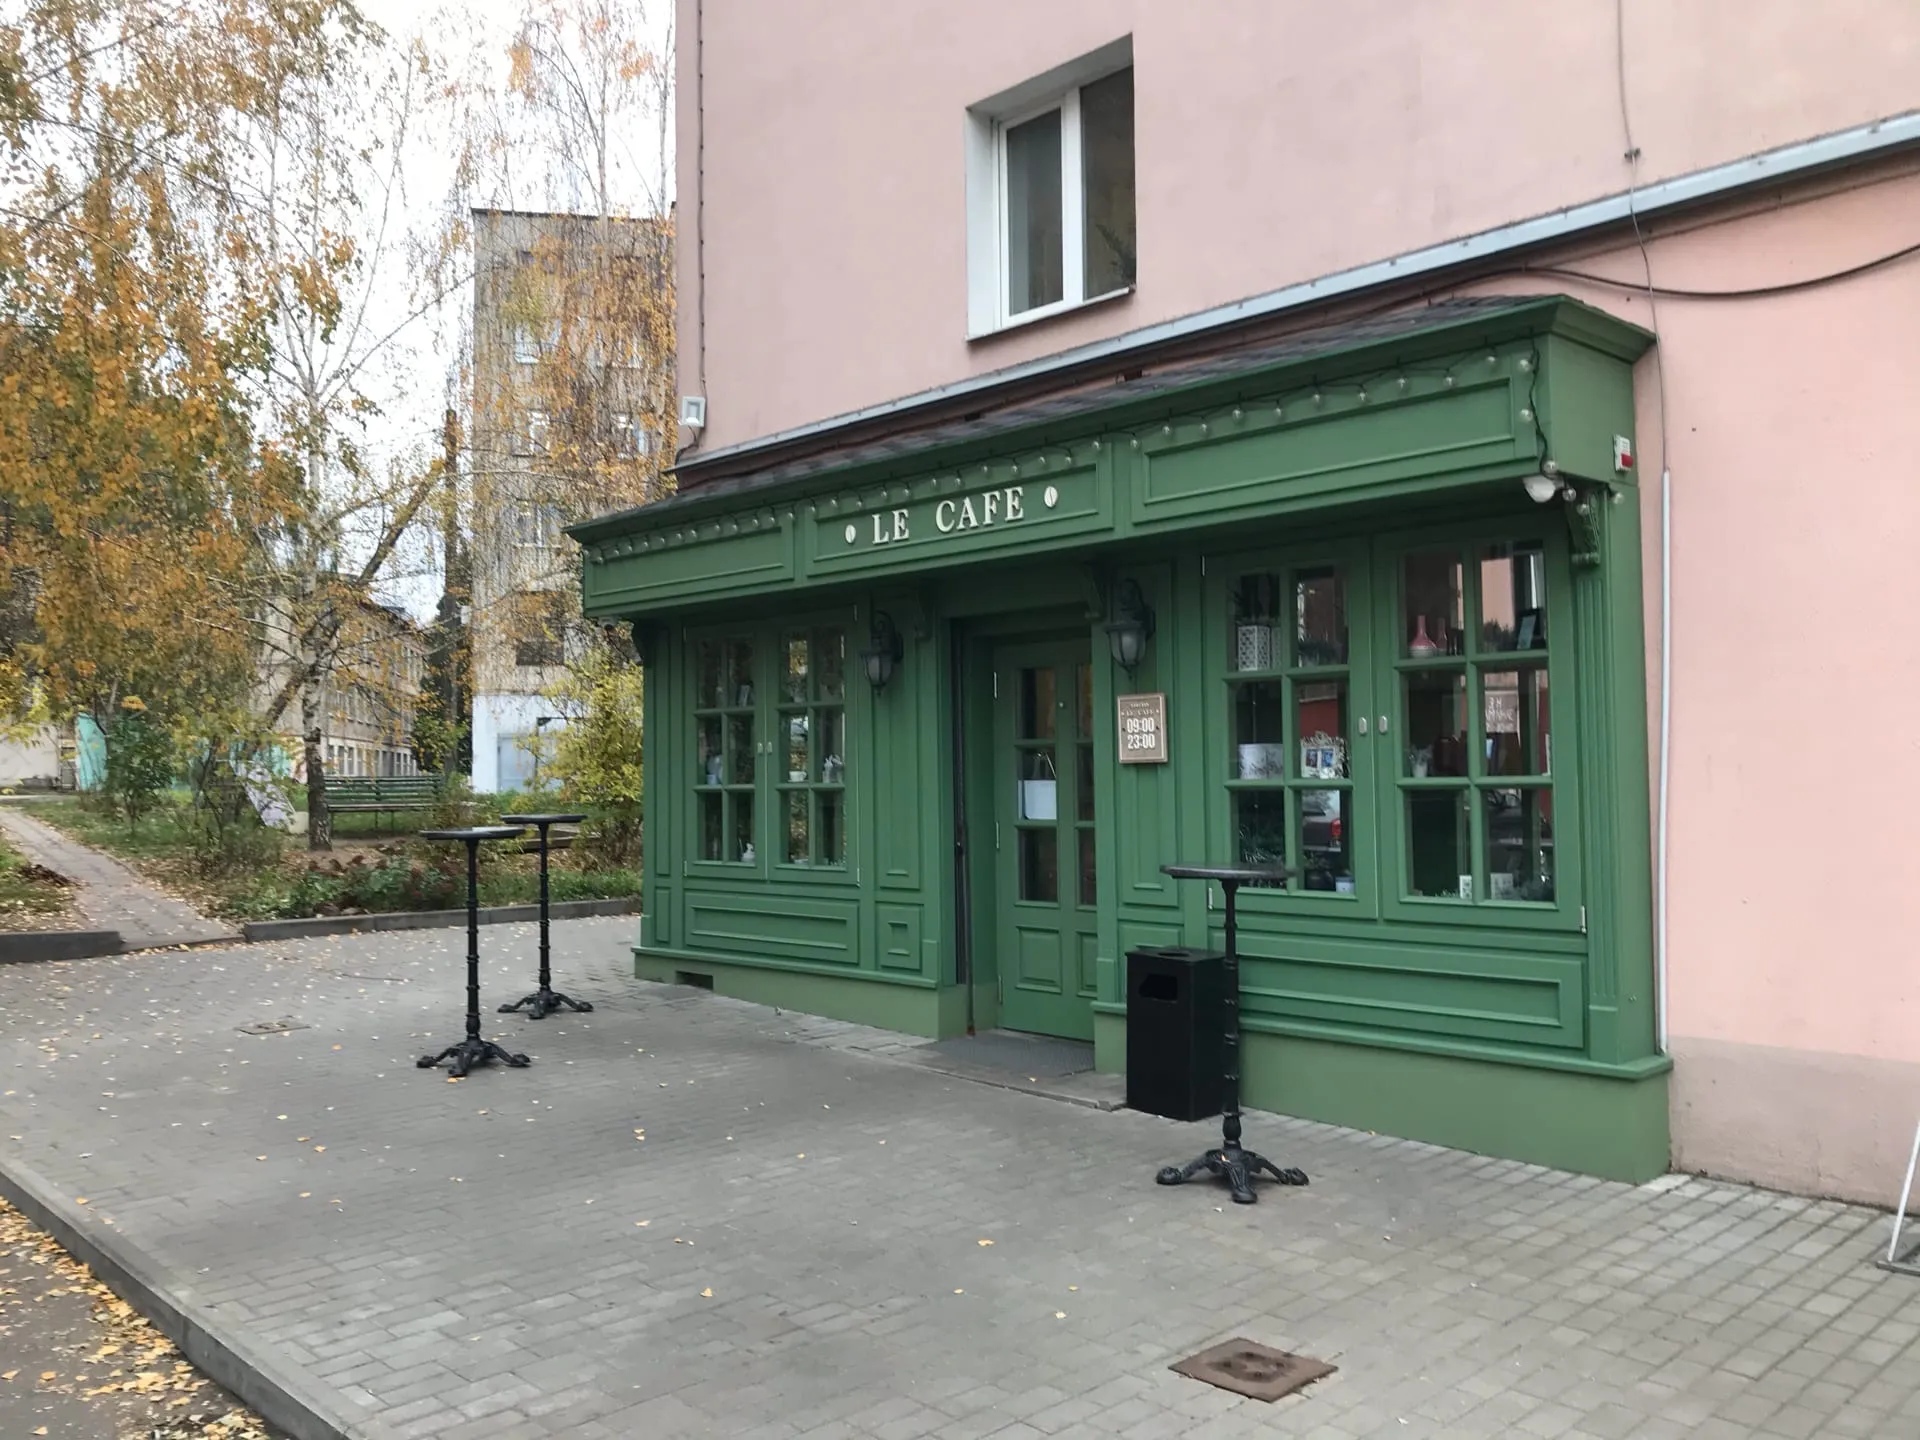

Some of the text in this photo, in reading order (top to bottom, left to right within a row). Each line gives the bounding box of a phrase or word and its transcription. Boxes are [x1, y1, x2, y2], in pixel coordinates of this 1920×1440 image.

[871, 486, 1025, 545] LE CAFE
[1126, 717, 1155, 733] 09:00
[1127, 734, 1156, 749] 23:00
